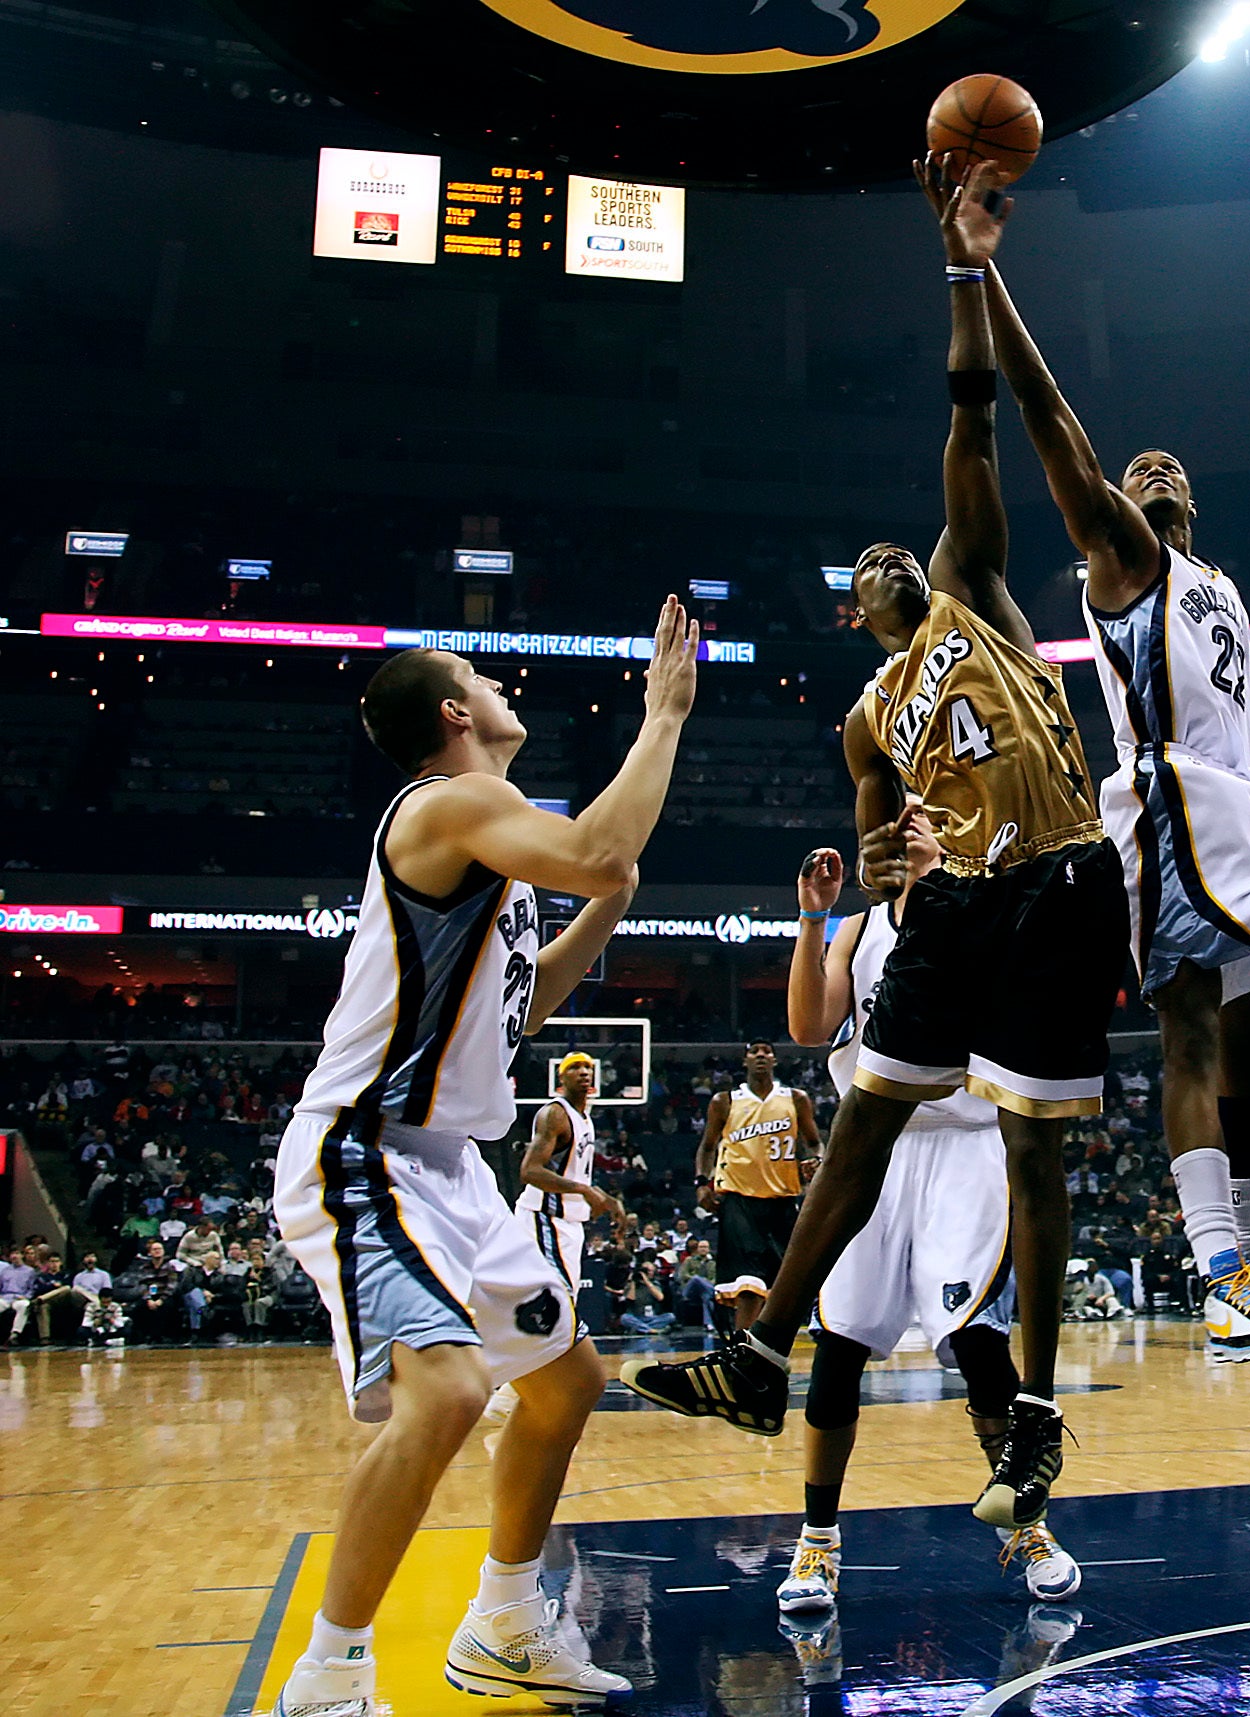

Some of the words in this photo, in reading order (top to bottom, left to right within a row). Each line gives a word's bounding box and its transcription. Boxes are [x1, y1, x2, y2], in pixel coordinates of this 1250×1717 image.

[590, 186, 661, 203] SOUTHERN
[600, 199, 652, 216] SPORTS
[594, 212, 656, 229] LEADERS.
[628, 240, 664, 253] SOUTH
[420, 629, 511, 654] MEMPHIS
[516, 633, 618, 658] GRIZZLIES
[950, 695, 1000, 767] 4
[150, 912, 306, 932] INTERNATIONAL
[612, 920, 716, 936] NATIONAL
[728, 1117, 792, 1144] WIZARDS
[769, 1135, 796, 1161] 32
